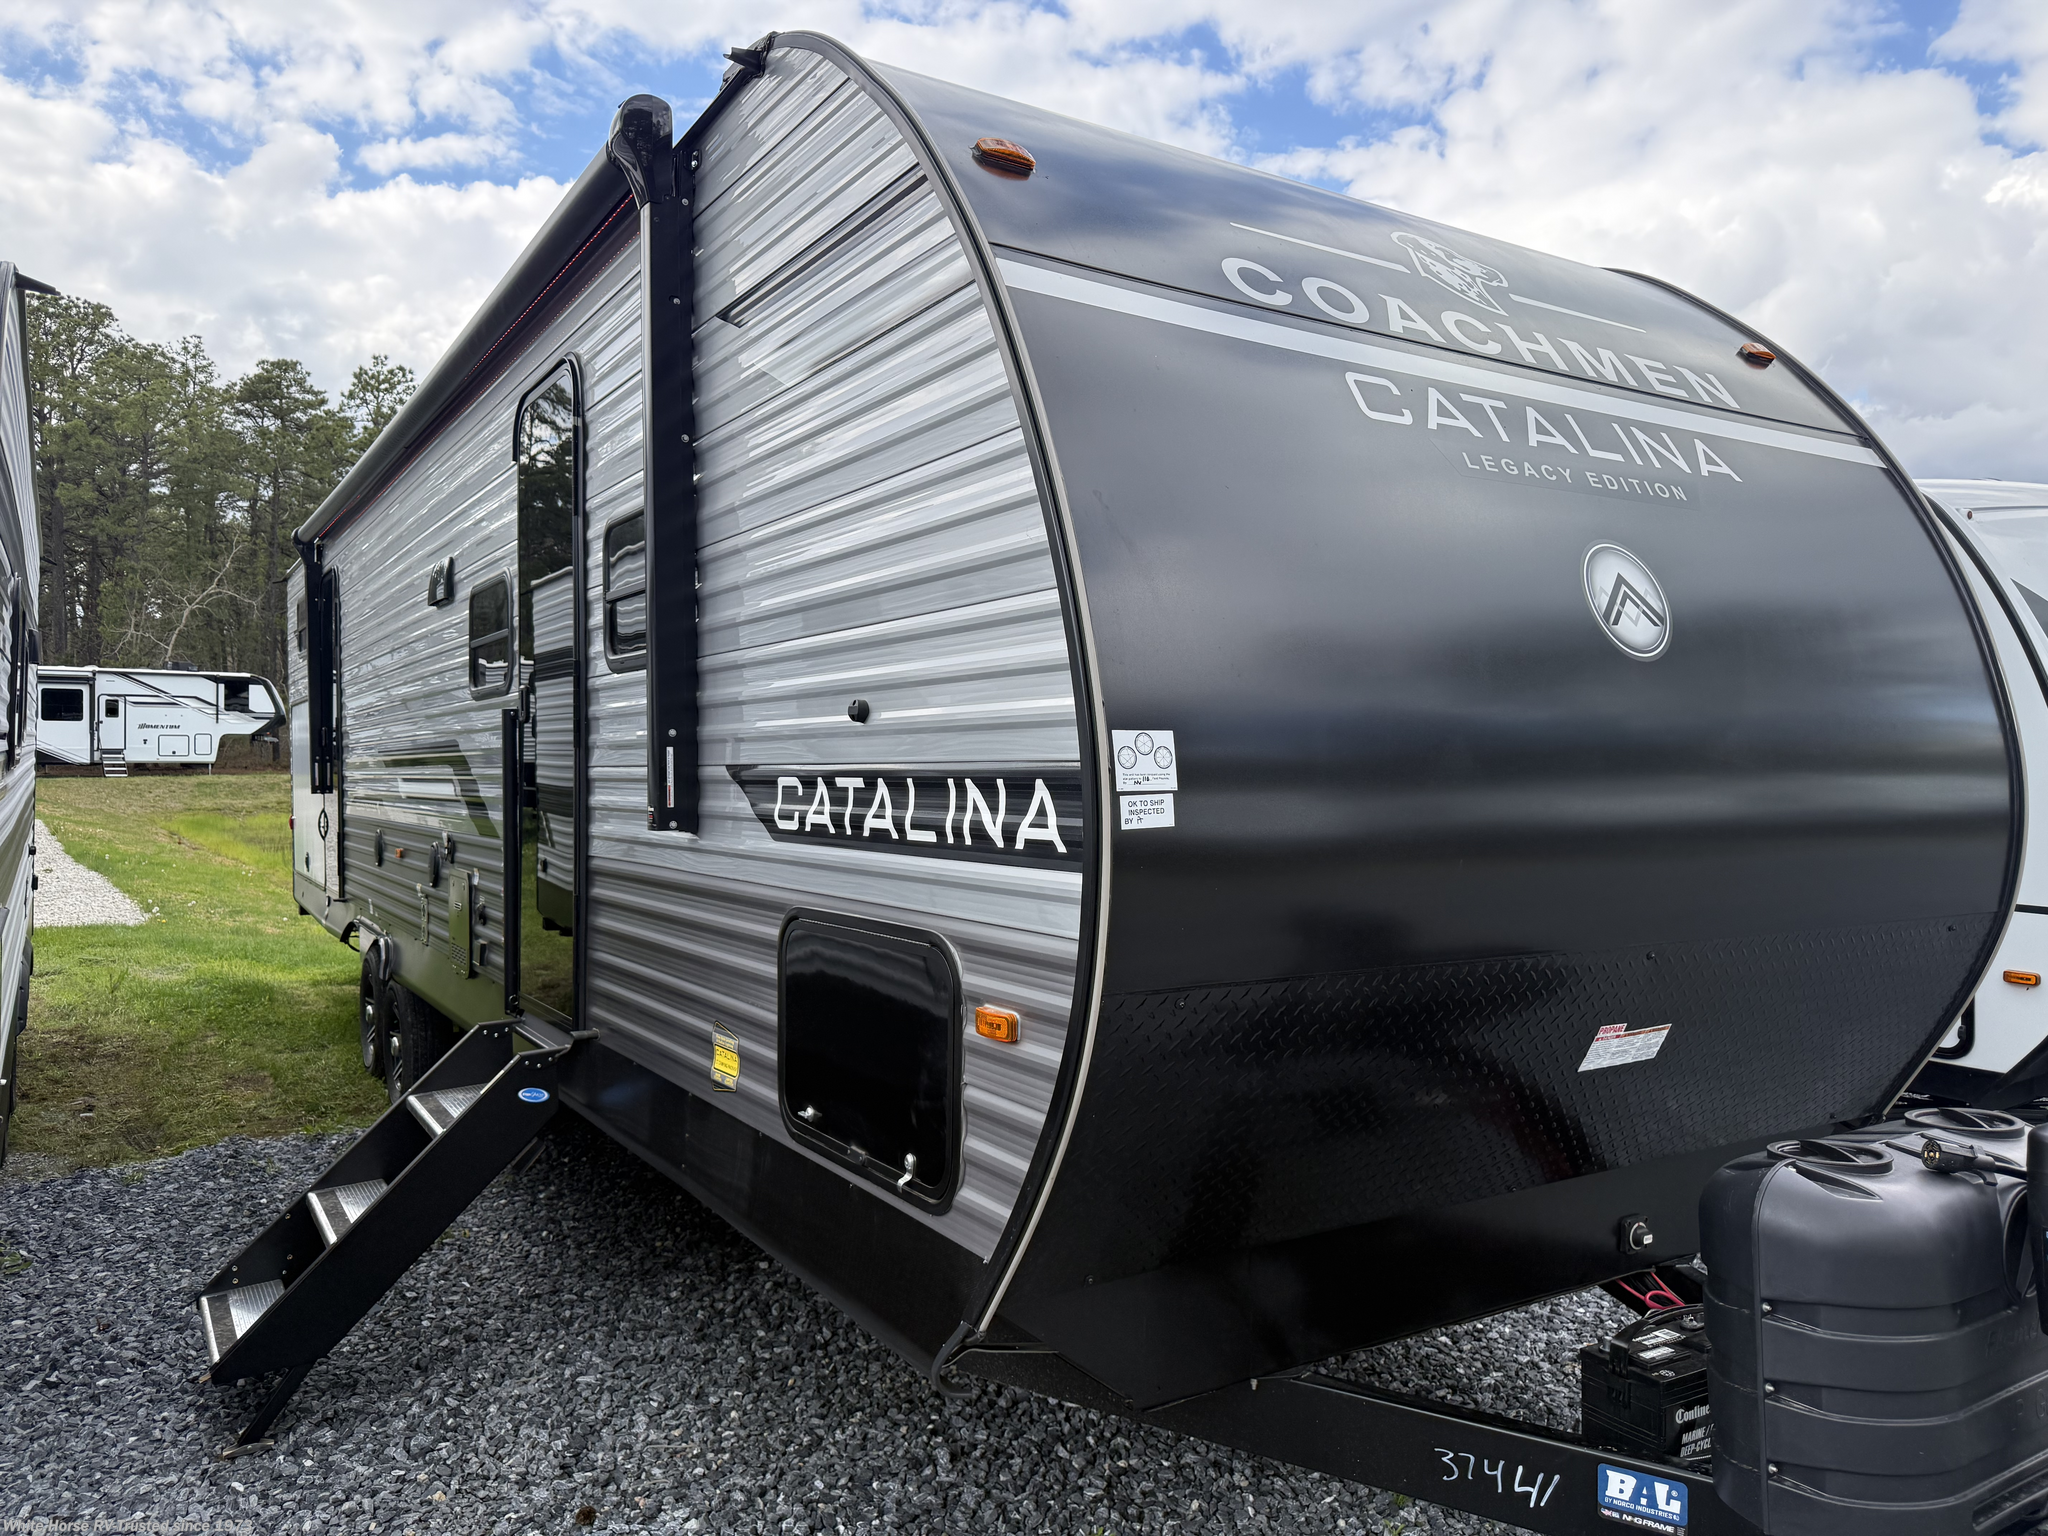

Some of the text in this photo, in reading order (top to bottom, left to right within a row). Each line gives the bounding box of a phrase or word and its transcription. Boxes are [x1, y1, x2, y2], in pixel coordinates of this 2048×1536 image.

[1220, 257, 1740, 409] COACHMEN
[1345, 370, 1743, 483] CATALINA
[1462, 452, 1688, 501] LEGACY EDITION
[1128, 800, 1138, 808] OK
[1139, 799, 1149, 807] TO
[1128, 807, 1165, 816] INSPECTED
[773, 776, 1067, 853] CATALINA
[1124, 817, 1133, 825] BY
[1598, 1024, 1625, 1035] PROPANE
[1604, 1496, 1674, 1520] BY NORCO INDUSTRIES
[1642, 1519, 1675, 1533] FRAME
